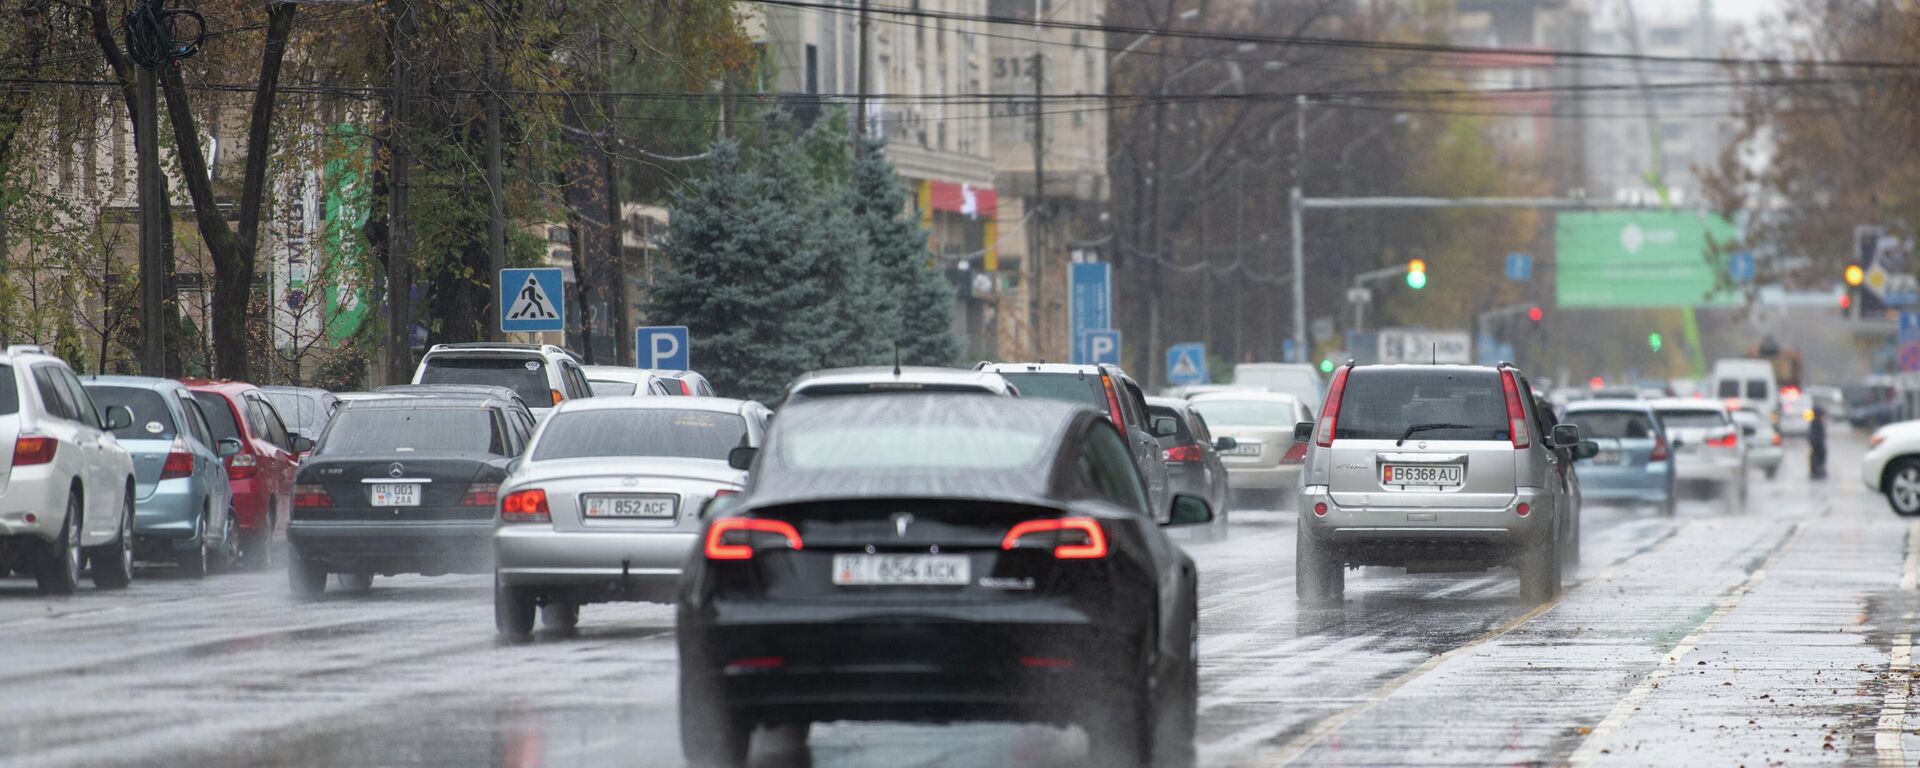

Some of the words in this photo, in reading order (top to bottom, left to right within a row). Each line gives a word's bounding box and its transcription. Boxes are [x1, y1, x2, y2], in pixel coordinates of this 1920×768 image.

[651, 333, 679, 370] P
[1092, 336, 1113, 363] P
[614, 500, 642, 514] 852
[643, 502, 668, 514] ACF
